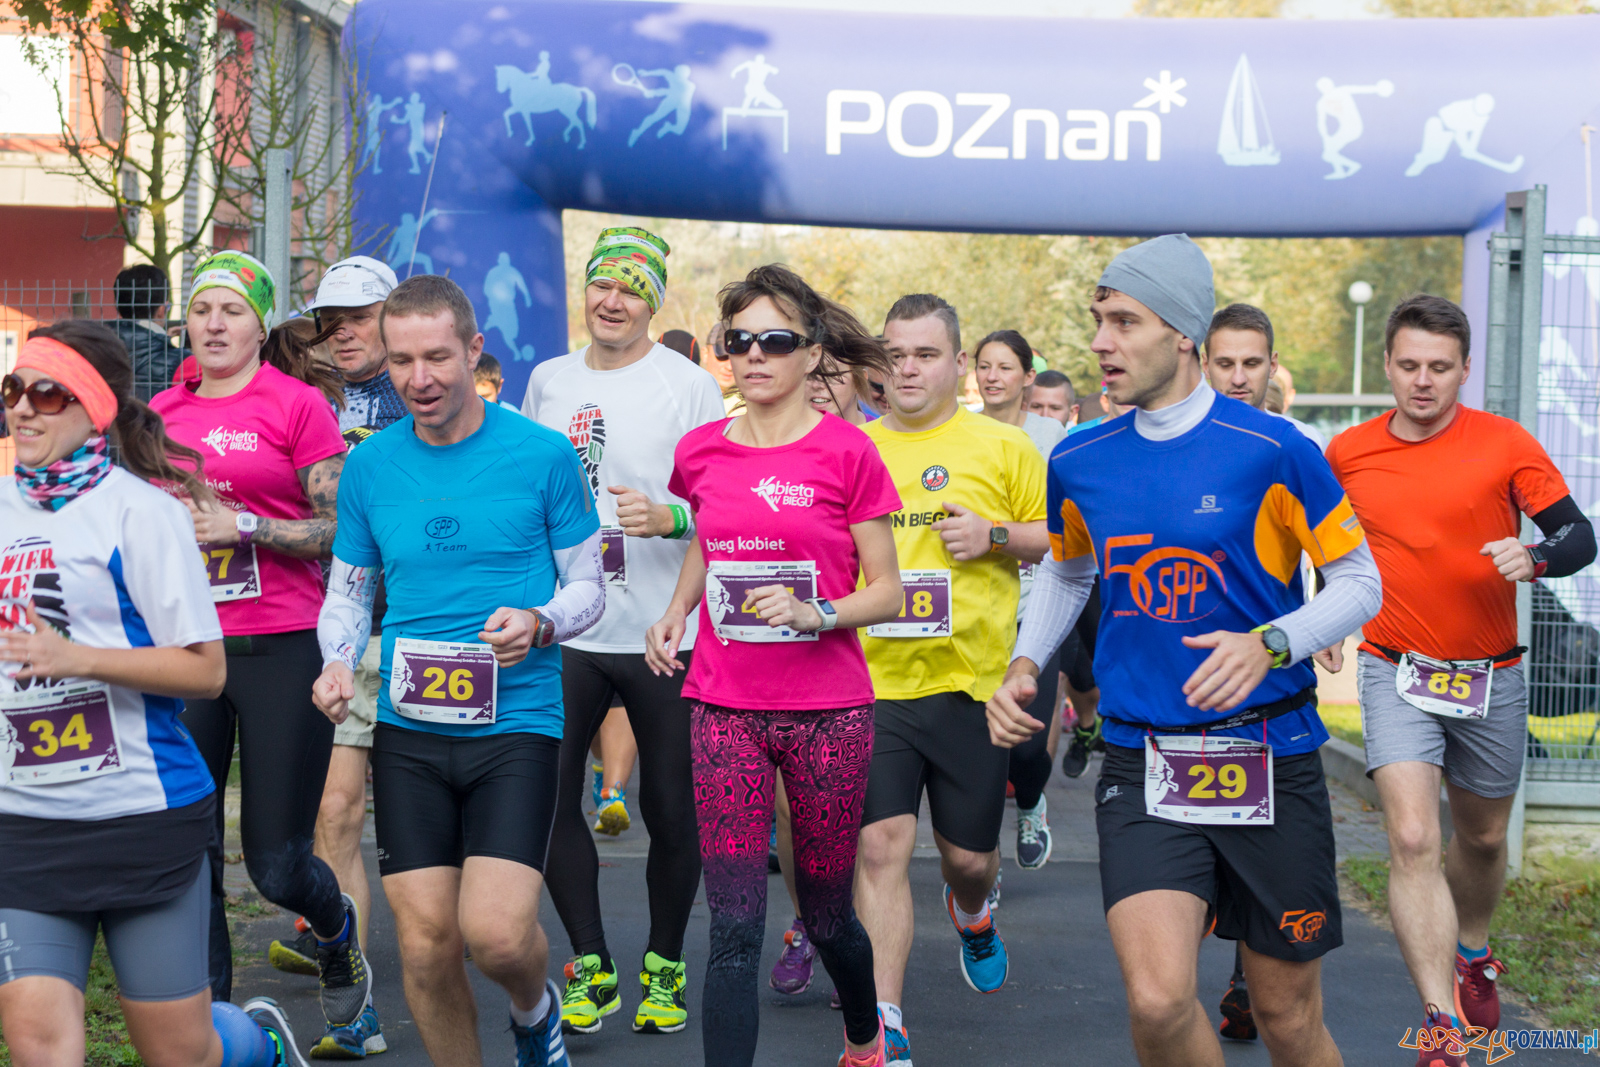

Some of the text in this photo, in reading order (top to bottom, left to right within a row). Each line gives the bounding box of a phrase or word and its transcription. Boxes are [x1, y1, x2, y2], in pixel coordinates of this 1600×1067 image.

[229, 441, 258, 452] BIEGU
[569, 432, 590, 447] WO
[782, 496, 814, 508] BIEGU
[435, 542, 468, 552] Team
[706, 536, 786, 553] bieg kobiet
[0, 547, 57, 575] WIER
[1155, 562, 1208, 620] SPP
[1112, 610, 1139, 618] years
[422, 666, 474, 701] 26
[1427, 672, 1473, 699] 85
[28, 713, 93, 758] 34
[1187, 764, 1248, 799] 29
